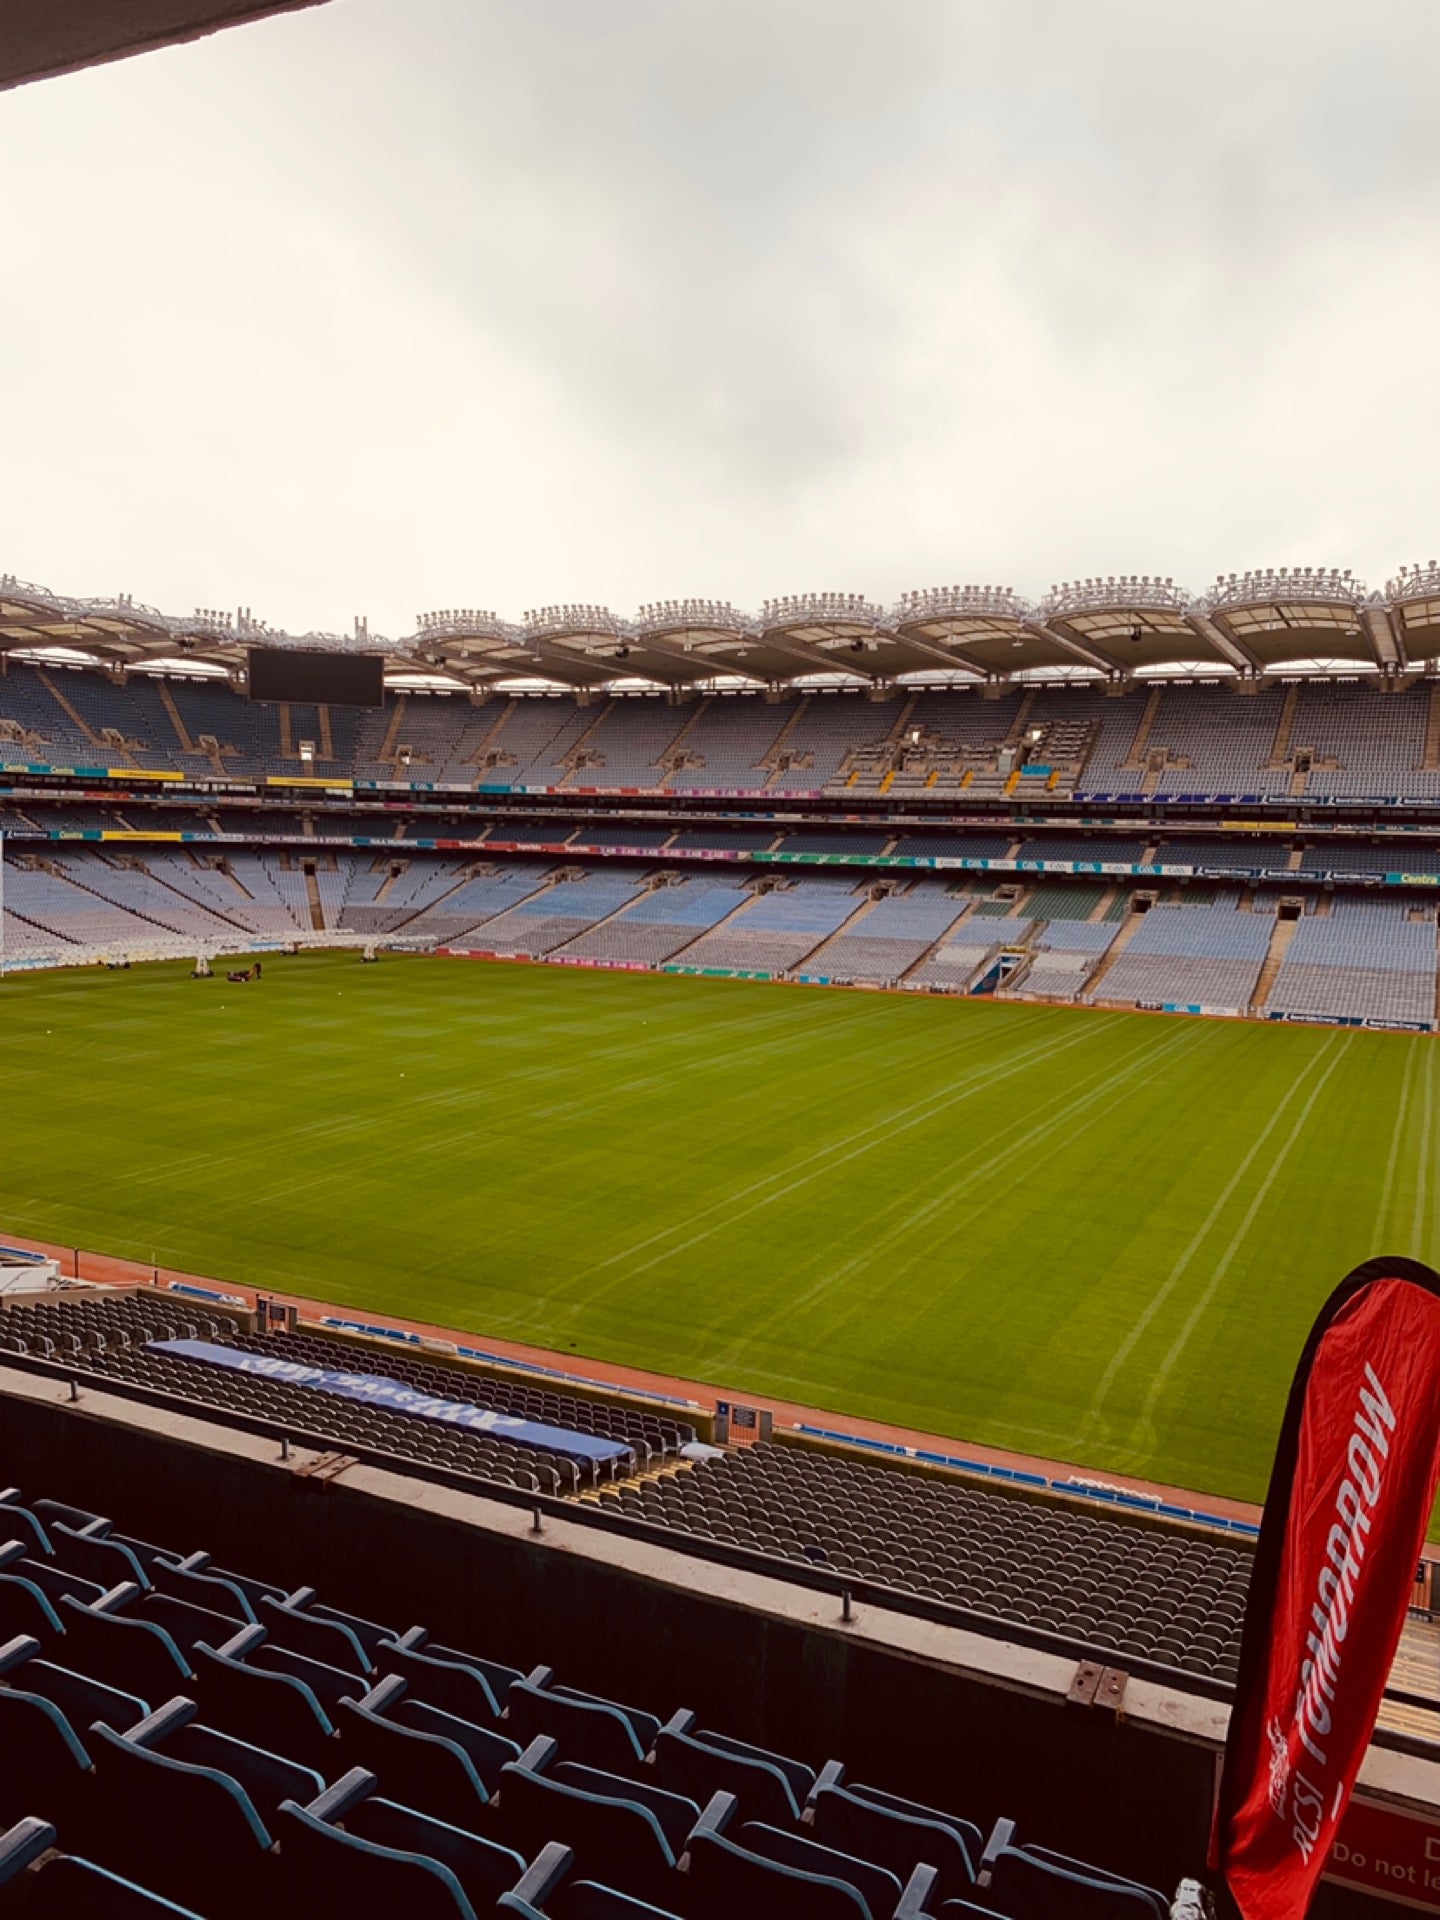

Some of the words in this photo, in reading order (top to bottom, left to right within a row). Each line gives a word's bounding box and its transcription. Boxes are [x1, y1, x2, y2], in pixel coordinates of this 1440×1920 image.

[1401, 873, 1438, 884] Centra
[1294, 1362, 1398, 1766] TOMORROW
[1291, 1771, 1325, 1867] RCSI
[1332, 1841, 1366, 1867] Do
[1375, 1858, 1416, 1884] not
